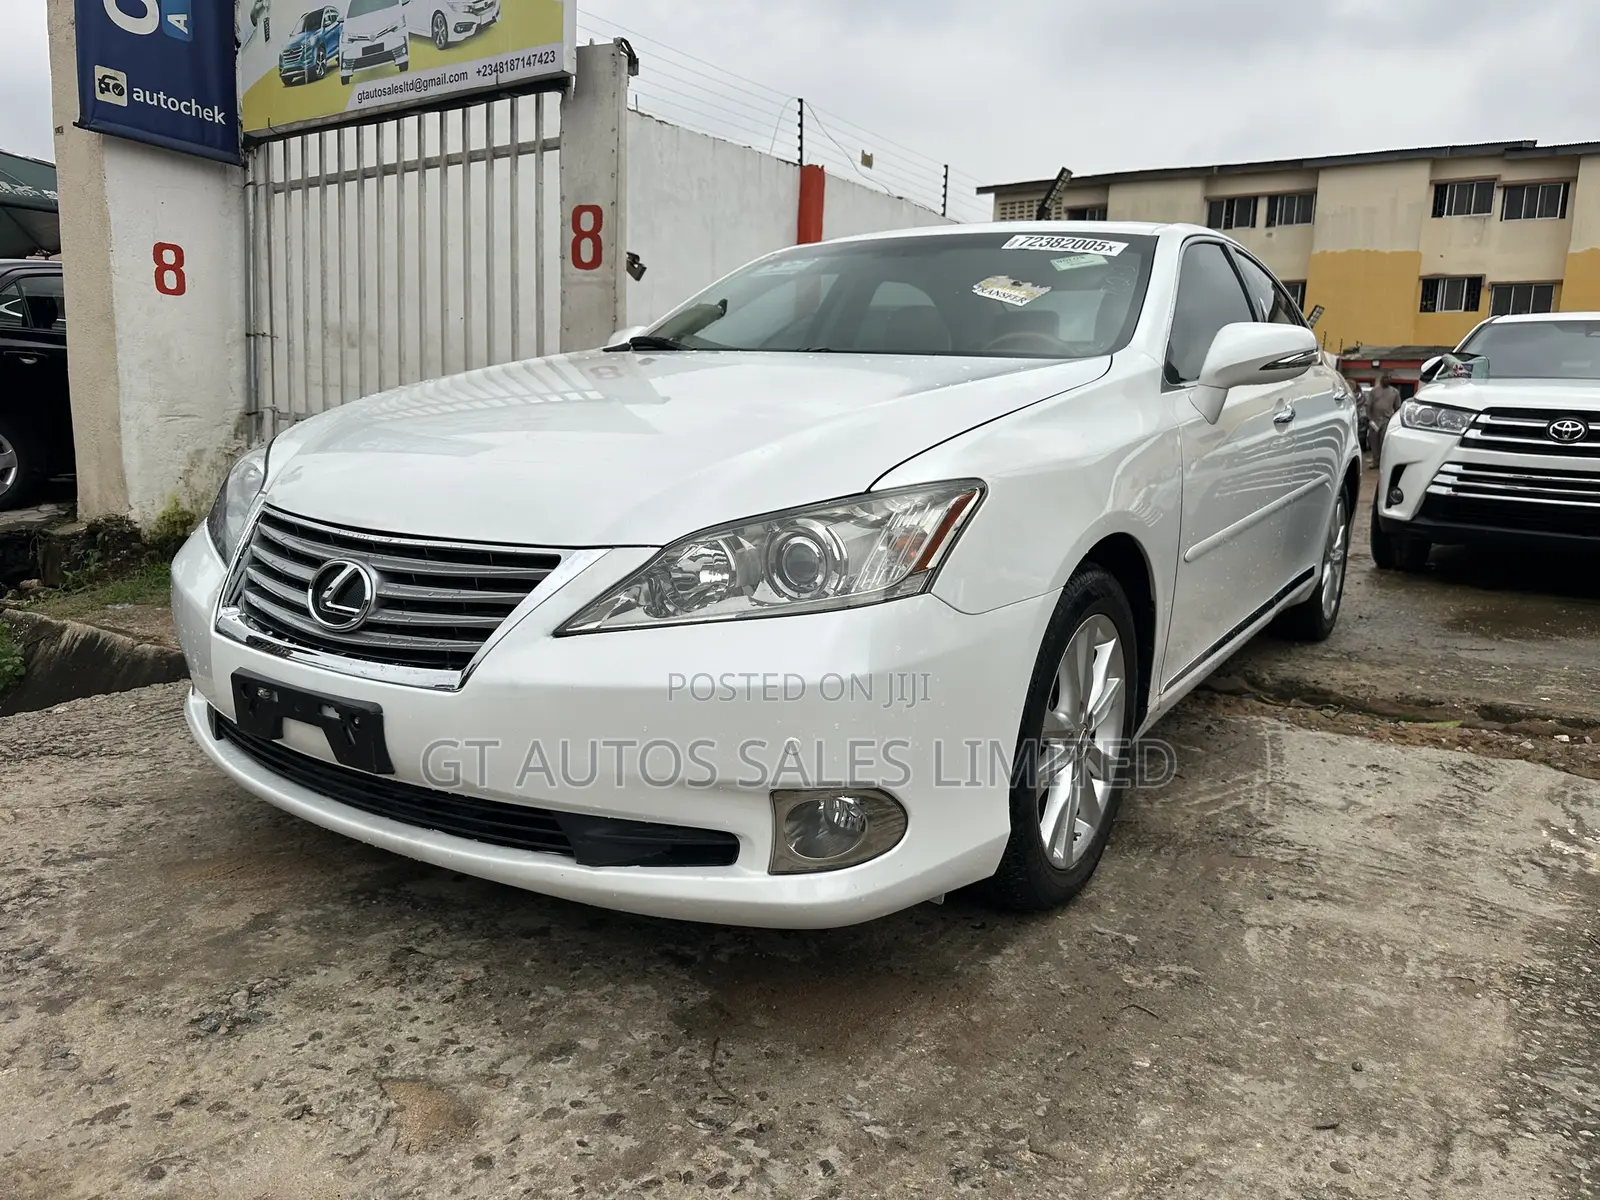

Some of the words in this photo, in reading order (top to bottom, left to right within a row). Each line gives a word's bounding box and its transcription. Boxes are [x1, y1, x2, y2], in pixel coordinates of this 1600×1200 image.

[356, 69, 468, 103] gtautosalesltd@gmail.com
[475, 50, 556, 78] +2348187147423
[132, 87, 227, 125] autochek
[571, 204, 603, 270] 8
[153, 241, 186, 296] 8
